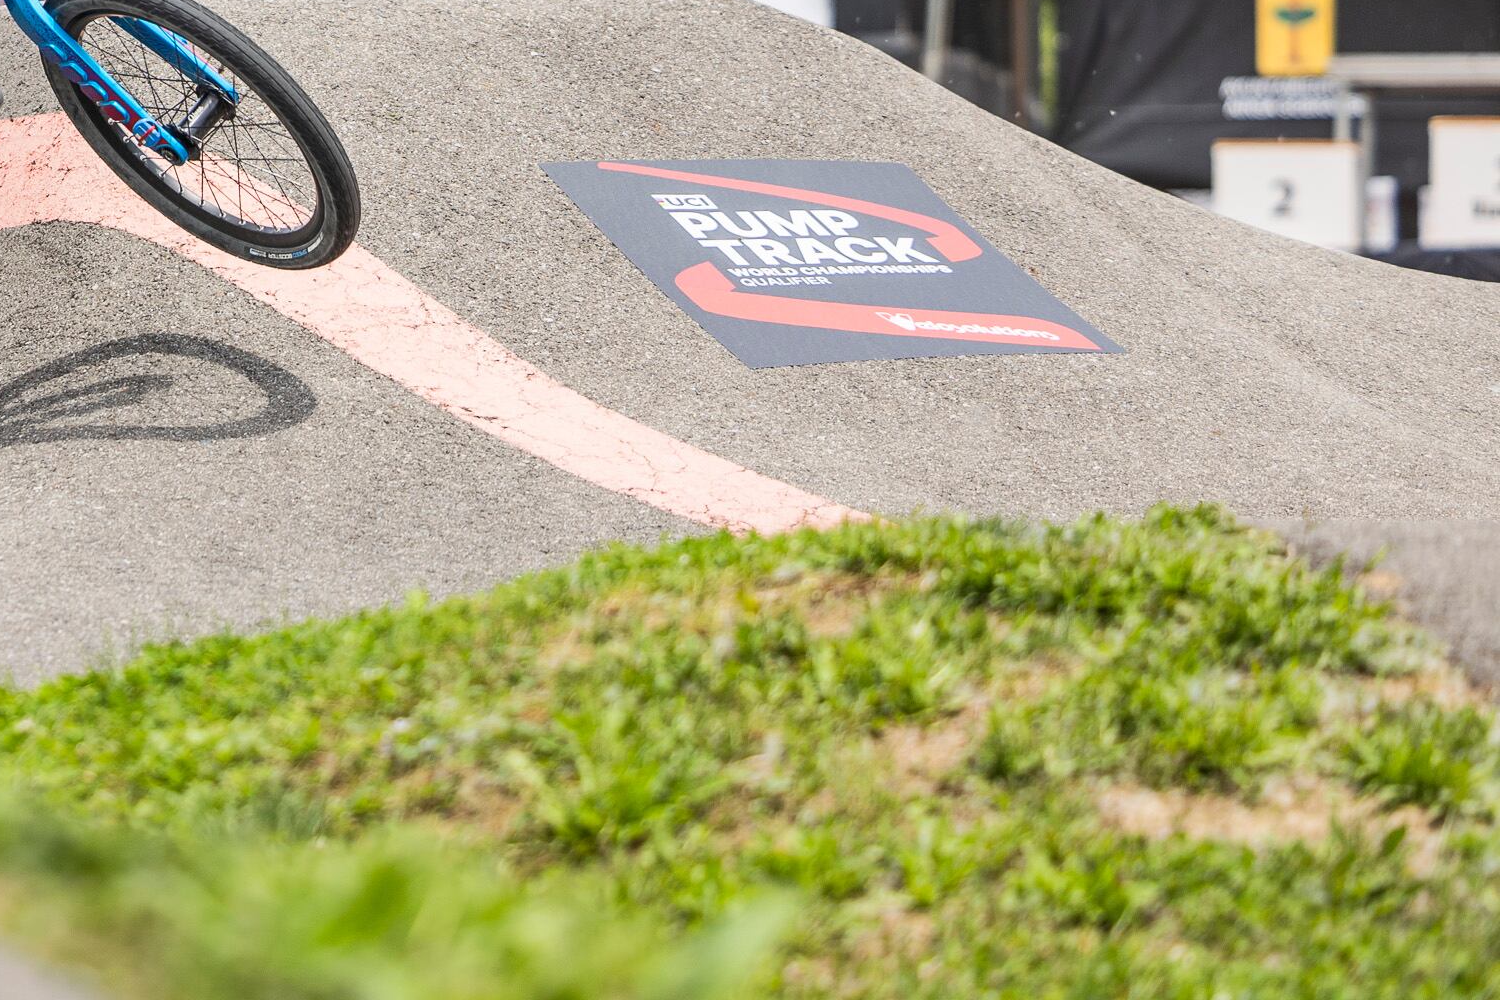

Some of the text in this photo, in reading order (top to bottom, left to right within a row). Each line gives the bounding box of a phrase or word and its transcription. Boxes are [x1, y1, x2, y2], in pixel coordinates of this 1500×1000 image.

[666, 197, 710, 207] UCI
[669, 209, 860, 239] PUMP
[698, 236, 940, 266] TRACK
[728, 265, 954, 278] WORLD CHAMPIONSHIPS
[740, 276, 832, 288] QUALIFIER
[874, 311, 1060, 341] Velosolutions
